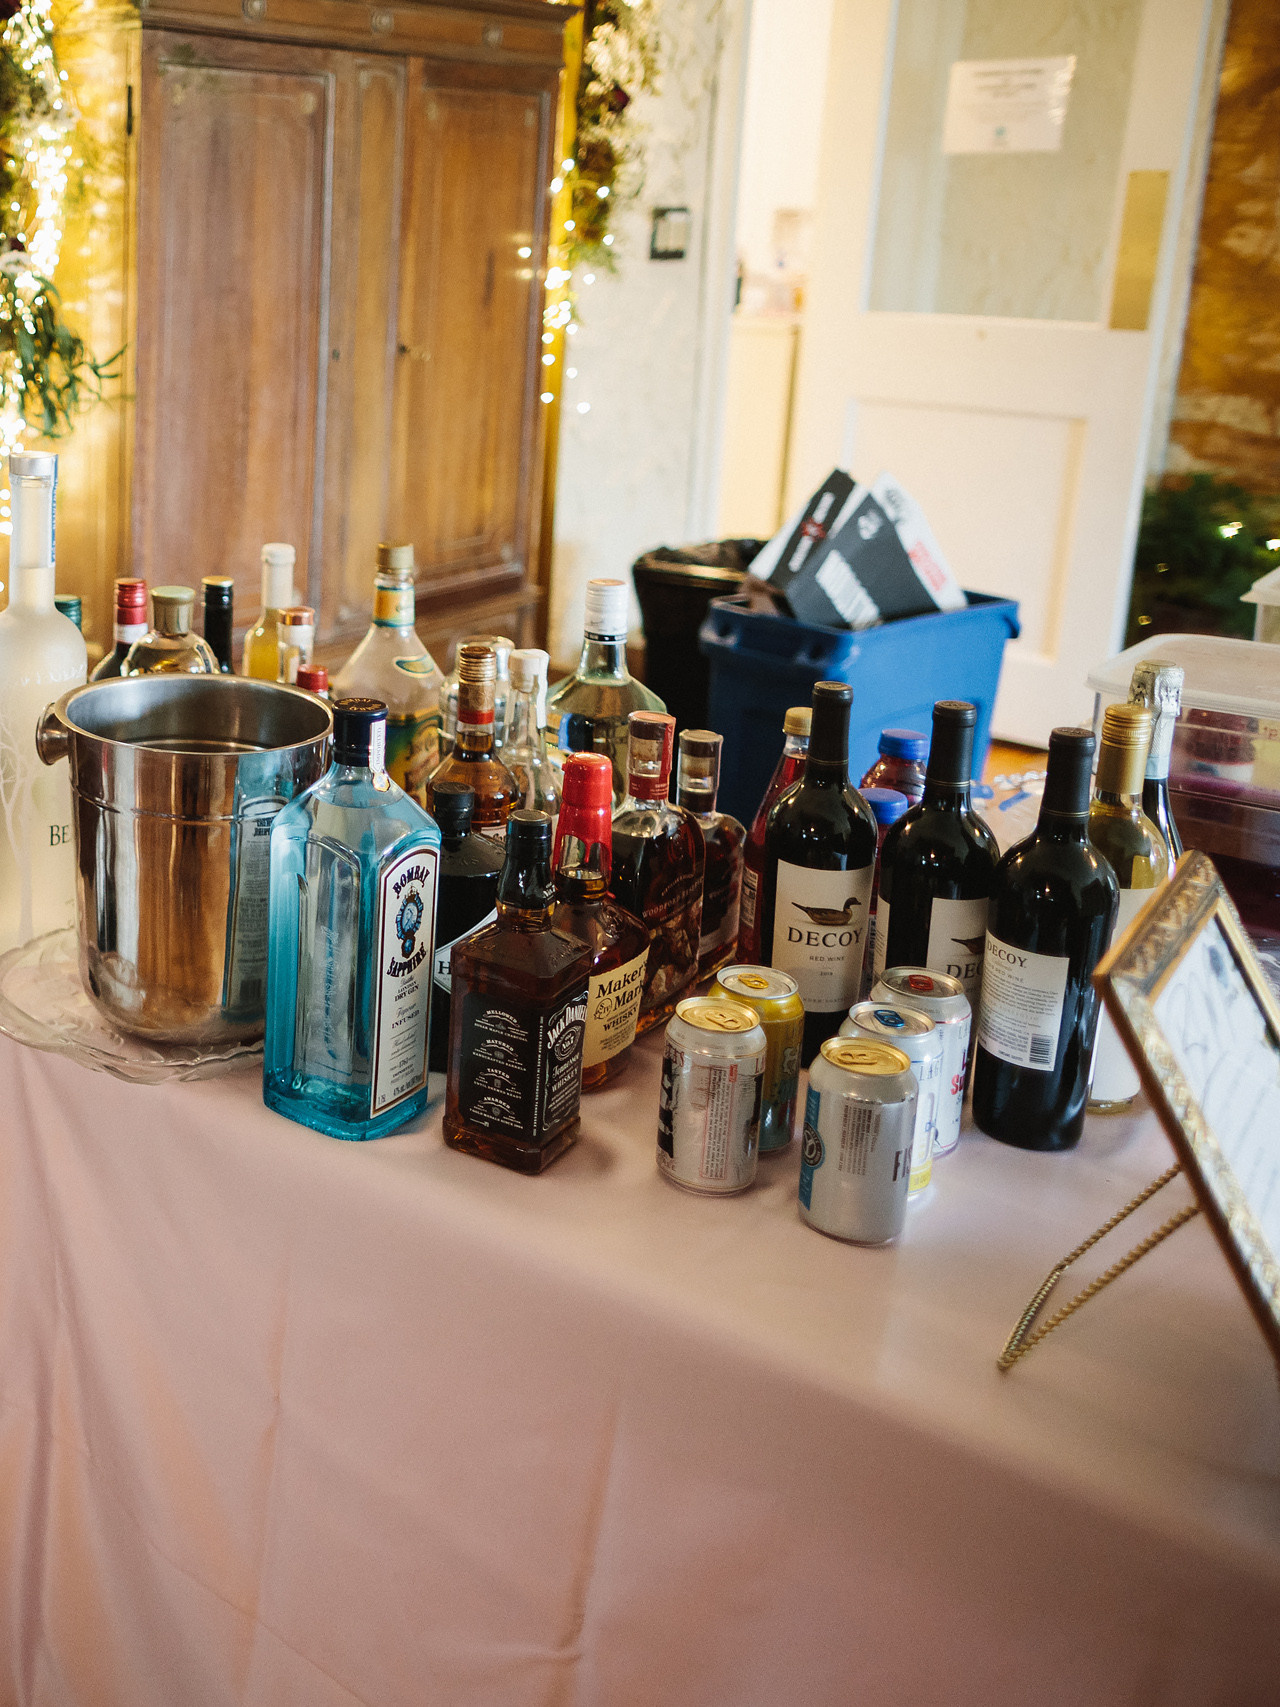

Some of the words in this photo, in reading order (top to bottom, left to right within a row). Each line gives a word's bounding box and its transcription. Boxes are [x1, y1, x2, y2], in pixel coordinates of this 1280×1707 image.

[392, 865, 430, 900] BOMBAY
[787, 926, 863, 948] DECOY
[386, 942, 427, 978] SAPPHIRE
[987, 941, 1028, 968] DECOY
[394, 991, 408, 1002] DRY
[408, 986, 420, 997] GIN
[391, 1009, 420, 1029] INFUSED
[486, 1009, 518, 1024] MELLOWED
[486, 1039, 514, 1052] MATURED
[487, 1068, 510, 1079] TASTED
[483, 1096, 511, 1109] AWARDED
